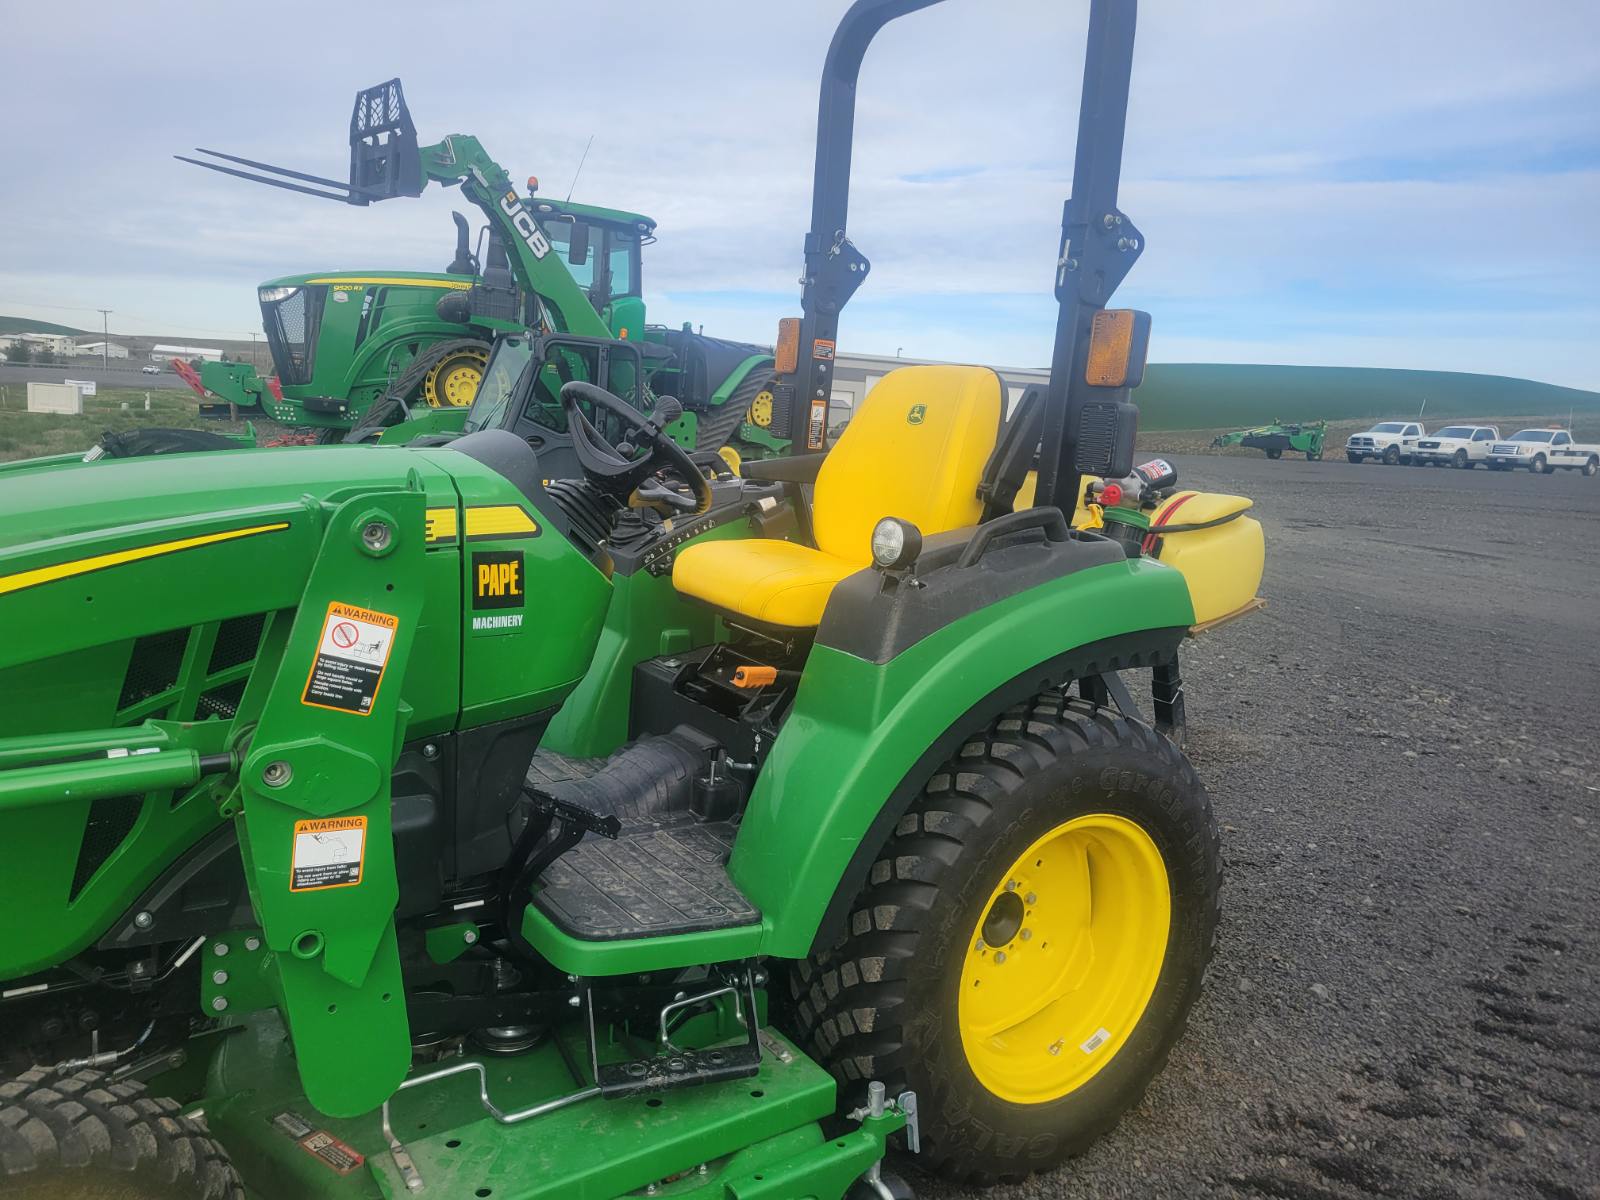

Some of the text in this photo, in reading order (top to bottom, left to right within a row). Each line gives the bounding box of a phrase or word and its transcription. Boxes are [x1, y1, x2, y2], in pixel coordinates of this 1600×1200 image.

[500, 197, 551, 260] JCB
[344, 606, 394, 627] WARNING
[472, 614, 524, 630] MACHINERY
[309, 818, 363, 830] WARNING
